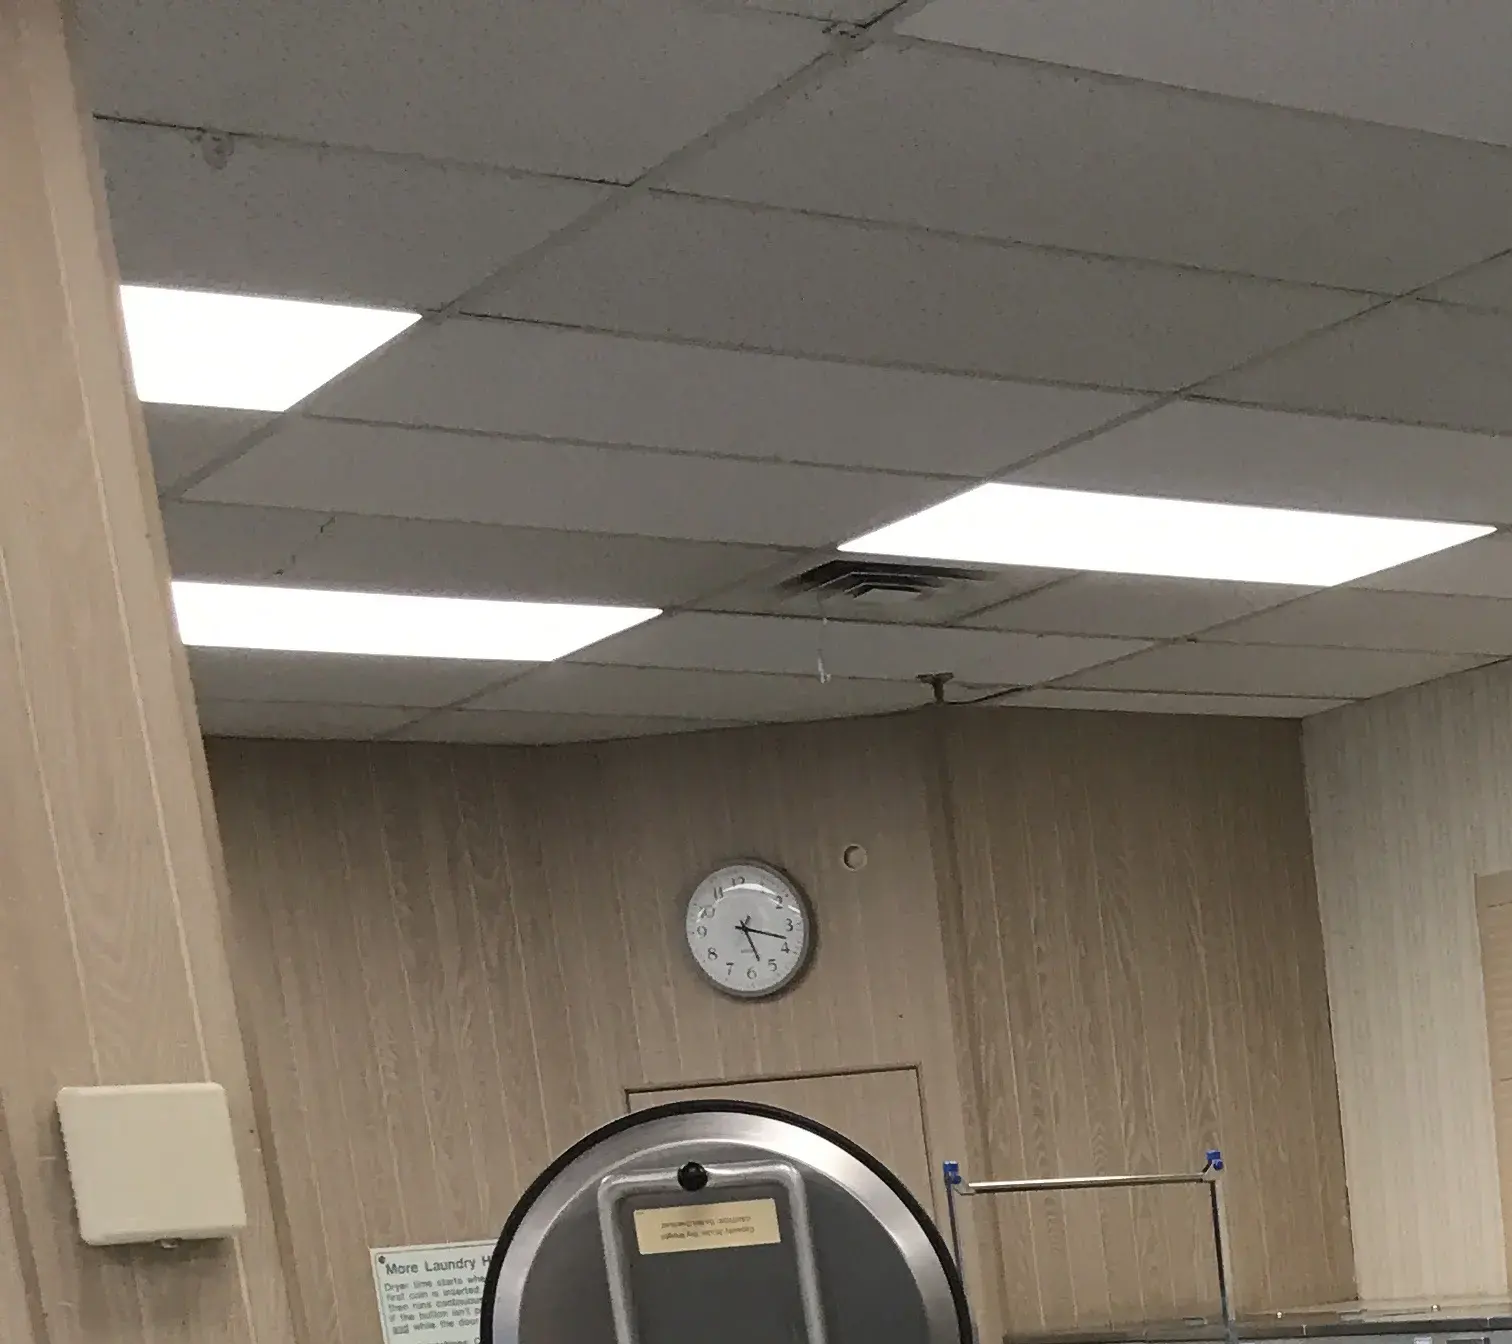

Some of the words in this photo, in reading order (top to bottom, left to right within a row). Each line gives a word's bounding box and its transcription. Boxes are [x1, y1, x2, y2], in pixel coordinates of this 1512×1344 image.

[785, 918, 794, 931] 3
[697, 925, 707, 938] 9
[708, 947, 718, 960] 8
[781, 942, 790, 953] 4
[726, 962, 734, 975] 7
[768, 958, 777, 971] 5
[747, 966, 757, 979] 6
[386, 1263, 418, 1275] More
[425, 1258, 476, 1272] Laundry
